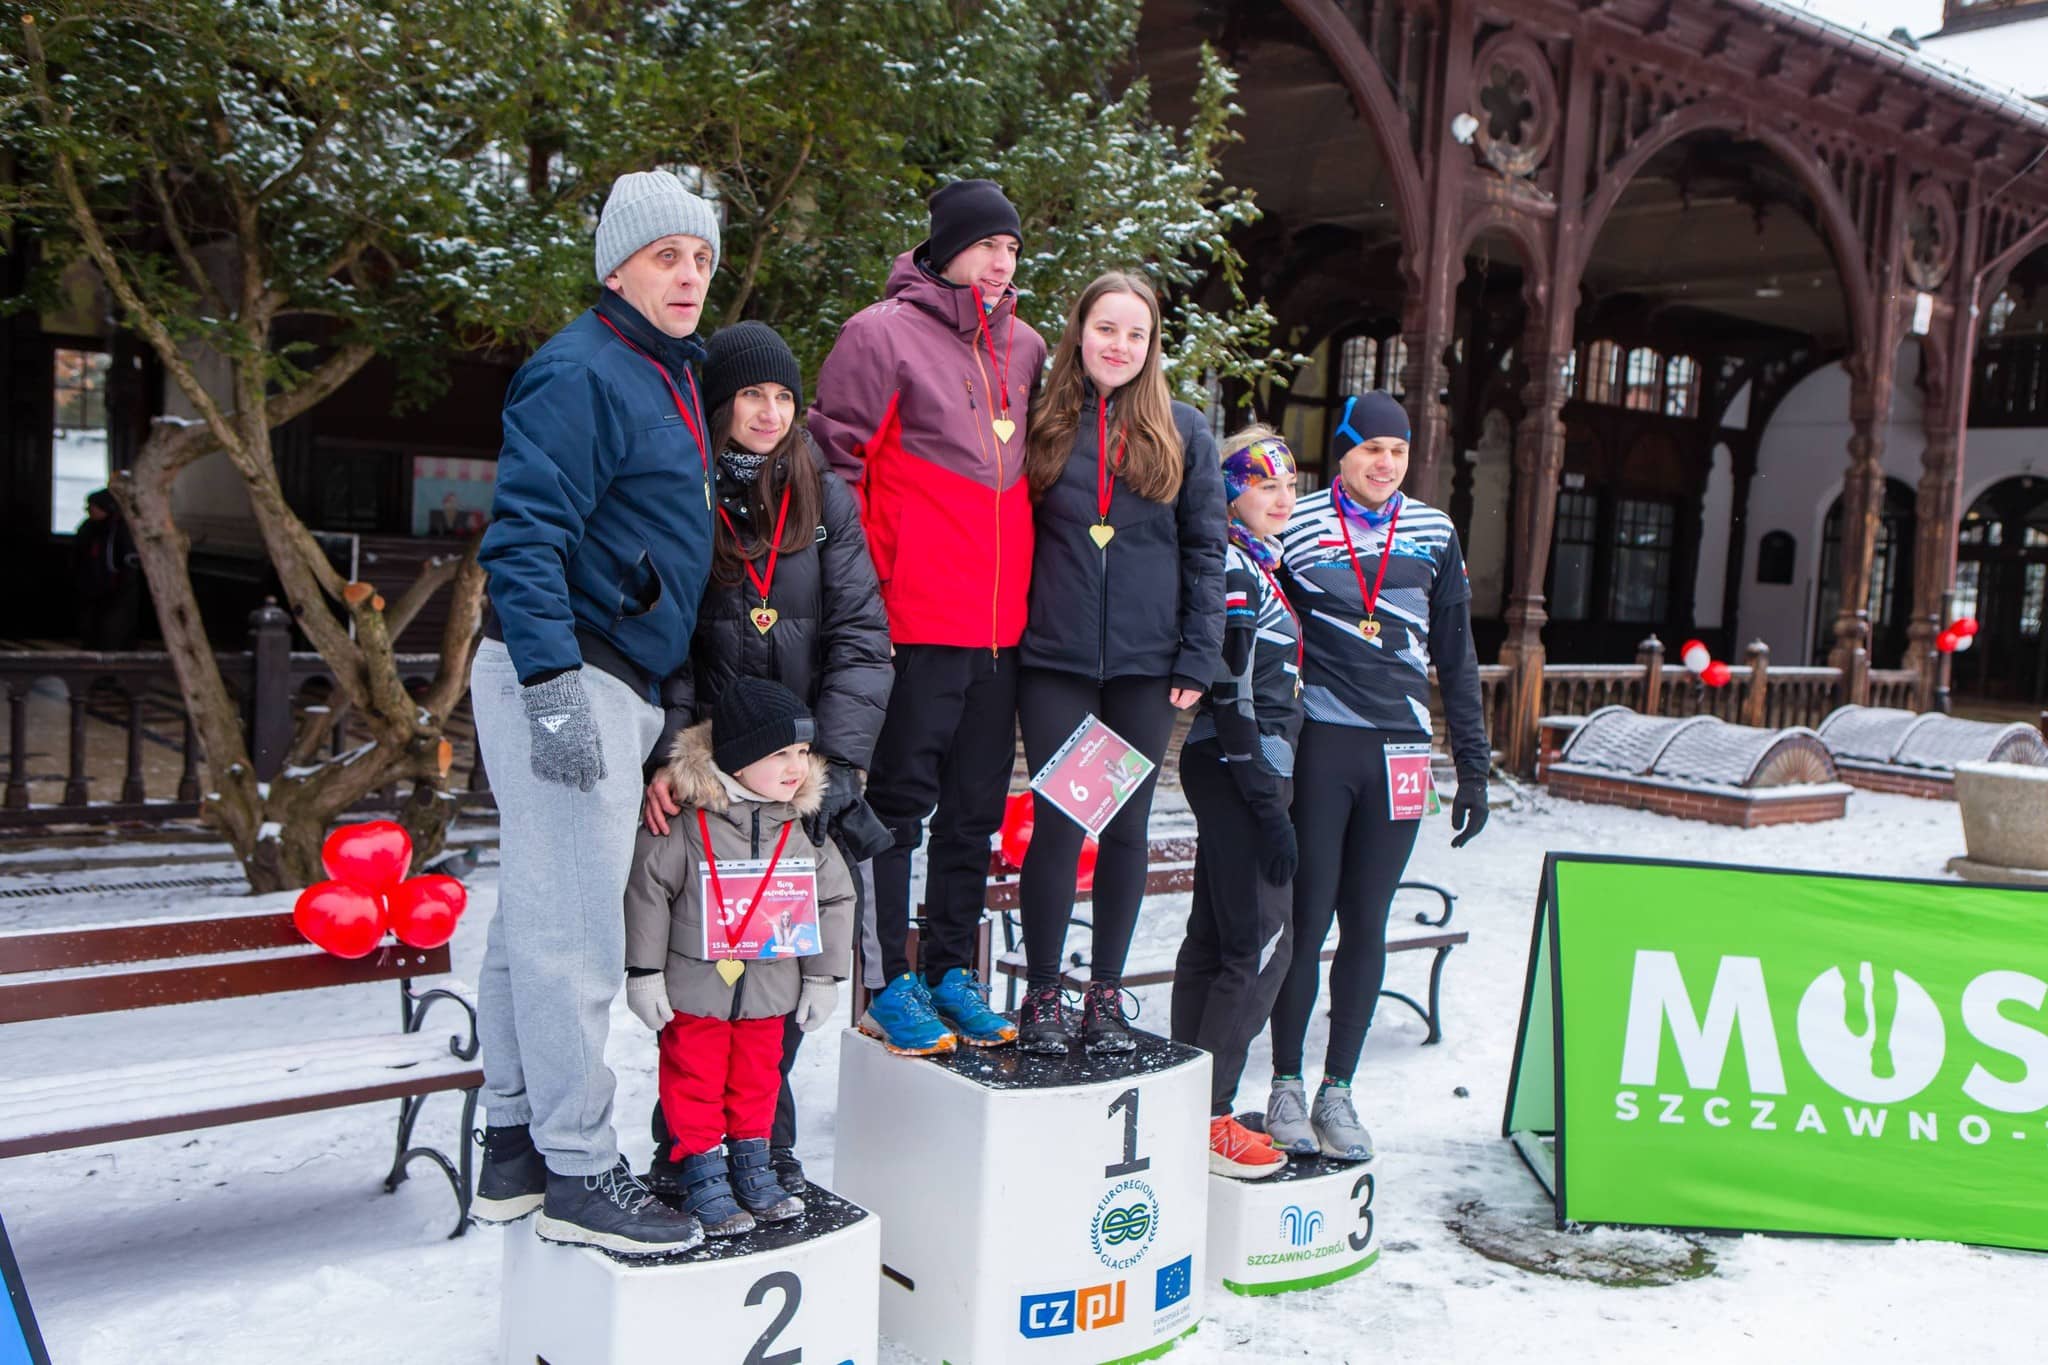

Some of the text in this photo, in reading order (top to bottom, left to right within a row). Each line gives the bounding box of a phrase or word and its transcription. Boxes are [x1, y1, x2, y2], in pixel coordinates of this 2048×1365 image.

[1070, 779, 1089, 802] 6
[1396, 772, 1421, 795] 21
[1105, 1088, 1150, 1179] 1
[1615, 1091, 2048, 1148] SZCZAWNO-
[1097, 1179, 1155, 1212] EUROREGION
[1348, 1173, 1375, 1252] 3
[1100, 1243, 1149, 1270] GLACENSIS
[1247, 1240, 1345, 1266] SZCZAWNO-ZDRÓJ
[743, 1271, 802, 1365] 2
